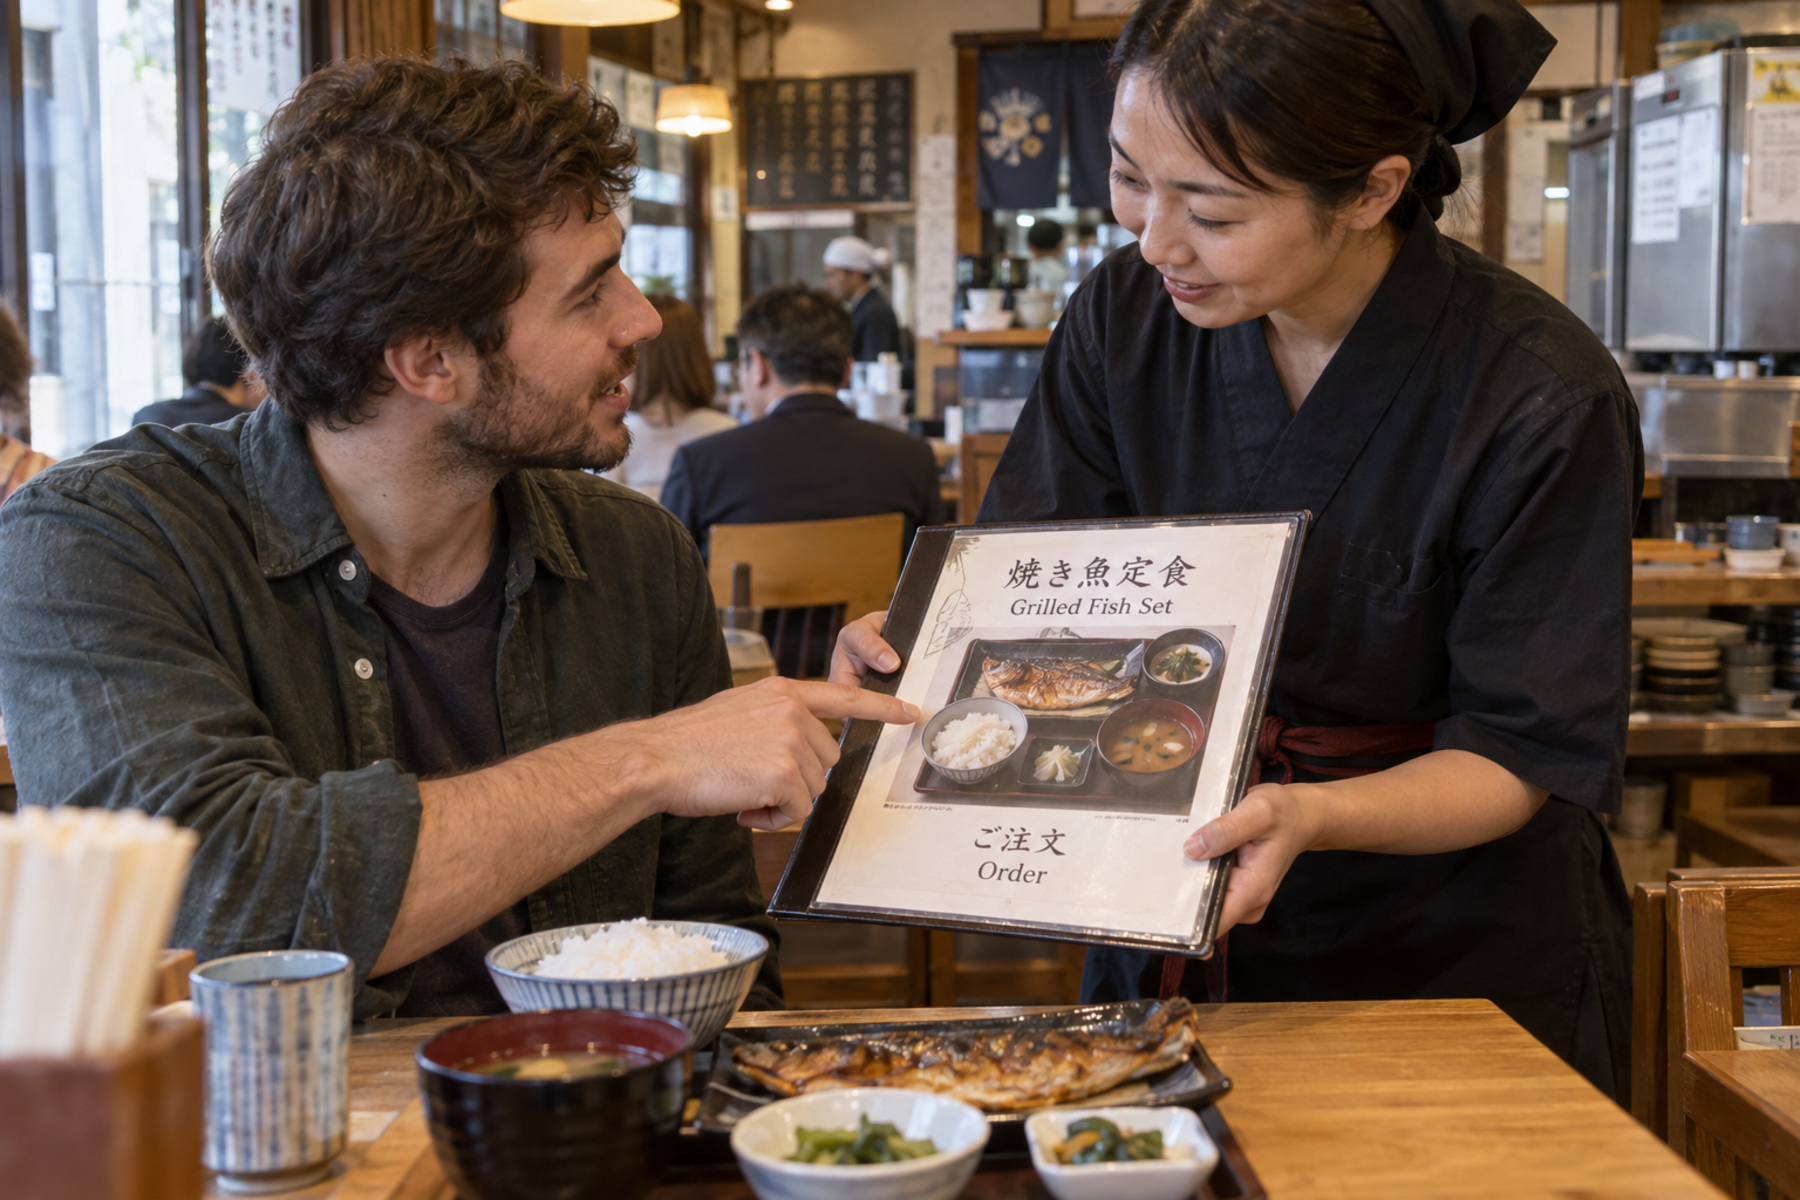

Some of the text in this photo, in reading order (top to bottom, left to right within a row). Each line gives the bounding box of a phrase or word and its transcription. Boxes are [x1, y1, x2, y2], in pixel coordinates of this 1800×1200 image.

[1003, 555, 1197, 589] 焼き魚定食
[1010, 597, 1173, 615] Grilled Fish Set
[974, 825, 1066, 856] ご注文
[978, 861, 1048, 884] Order
